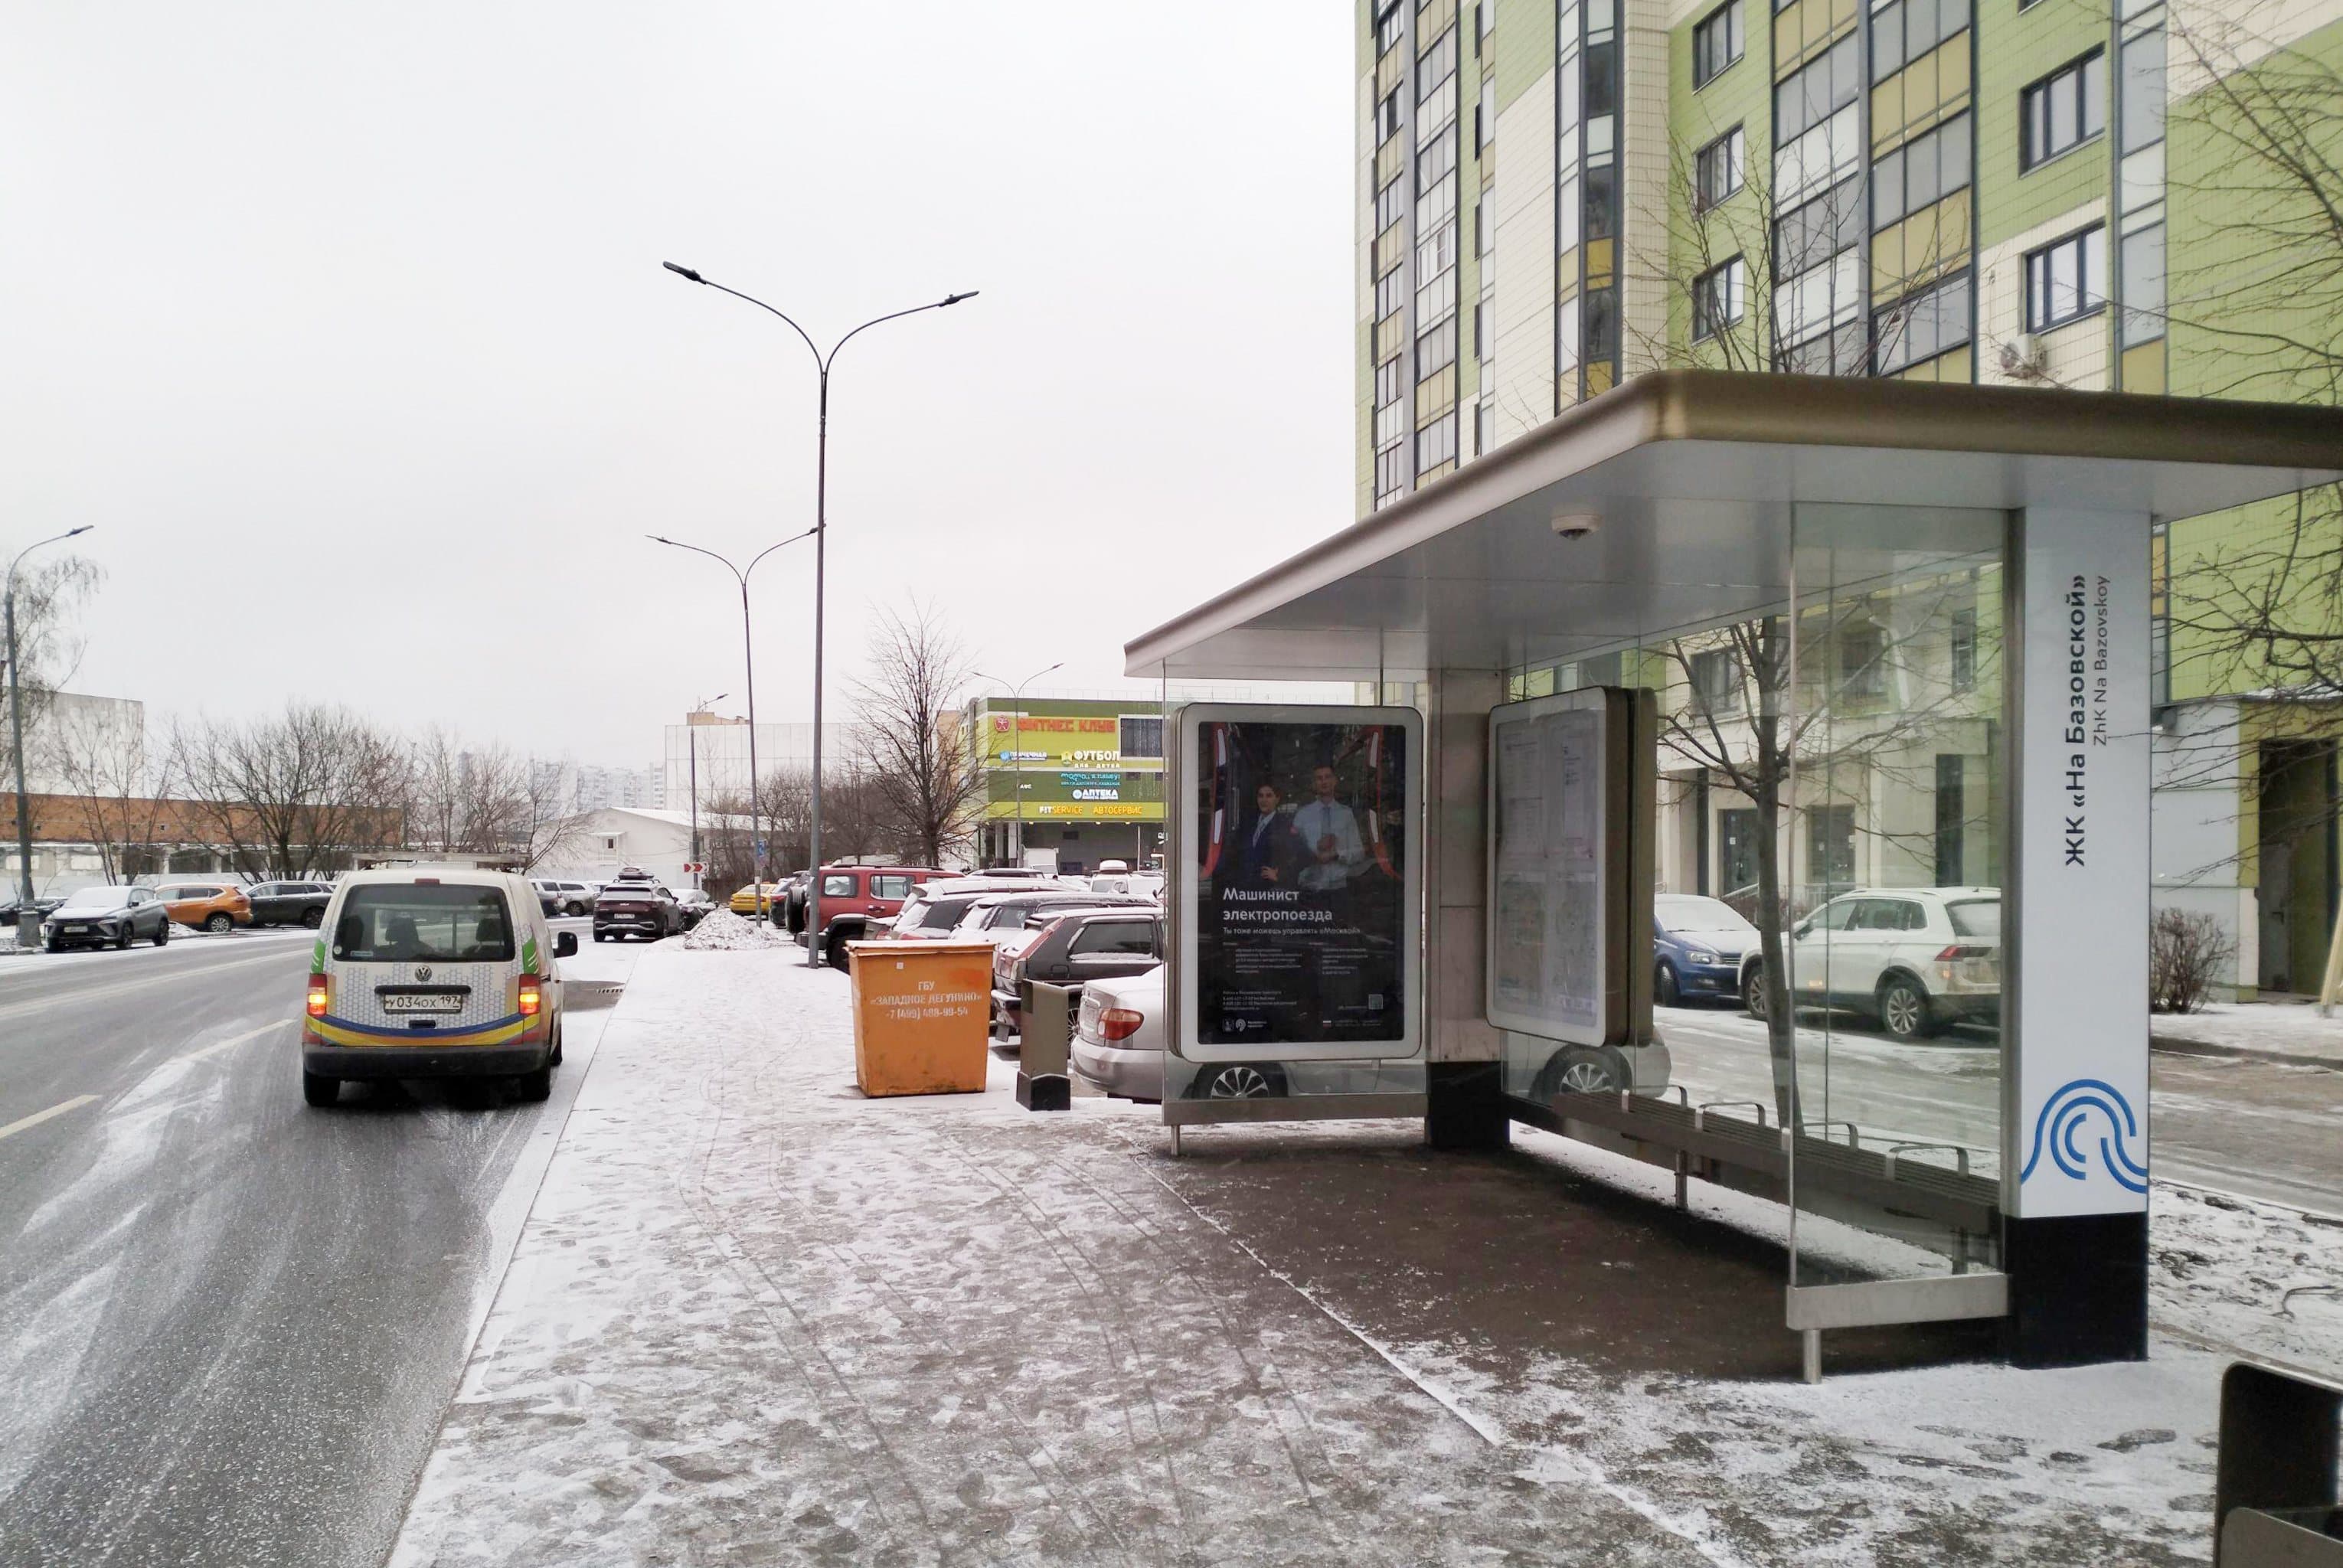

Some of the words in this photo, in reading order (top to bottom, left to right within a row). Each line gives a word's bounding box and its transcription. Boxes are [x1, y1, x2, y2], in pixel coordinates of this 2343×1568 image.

[2093, 575, 2110, 671] Bazovskoy
[2064, 575, 2086, 743] Базовской»
[2093, 677, 2107, 703] Na
[2093, 706, 2107, 747] ZhK
[1073, 750, 1120, 761] ФУТБОЛ
[2065, 753, 2086, 807] «На
[1093, 805, 1143, 815] АВТОСЕРВИС
[2065, 815, 2086, 867] ЖК
[1223, 887, 1299, 900] Машинист
[1223, 910, 1333, 923] электропоезда
[918, 981, 935, 991] ГБУ
[440, 996, 459, 1004] 197
